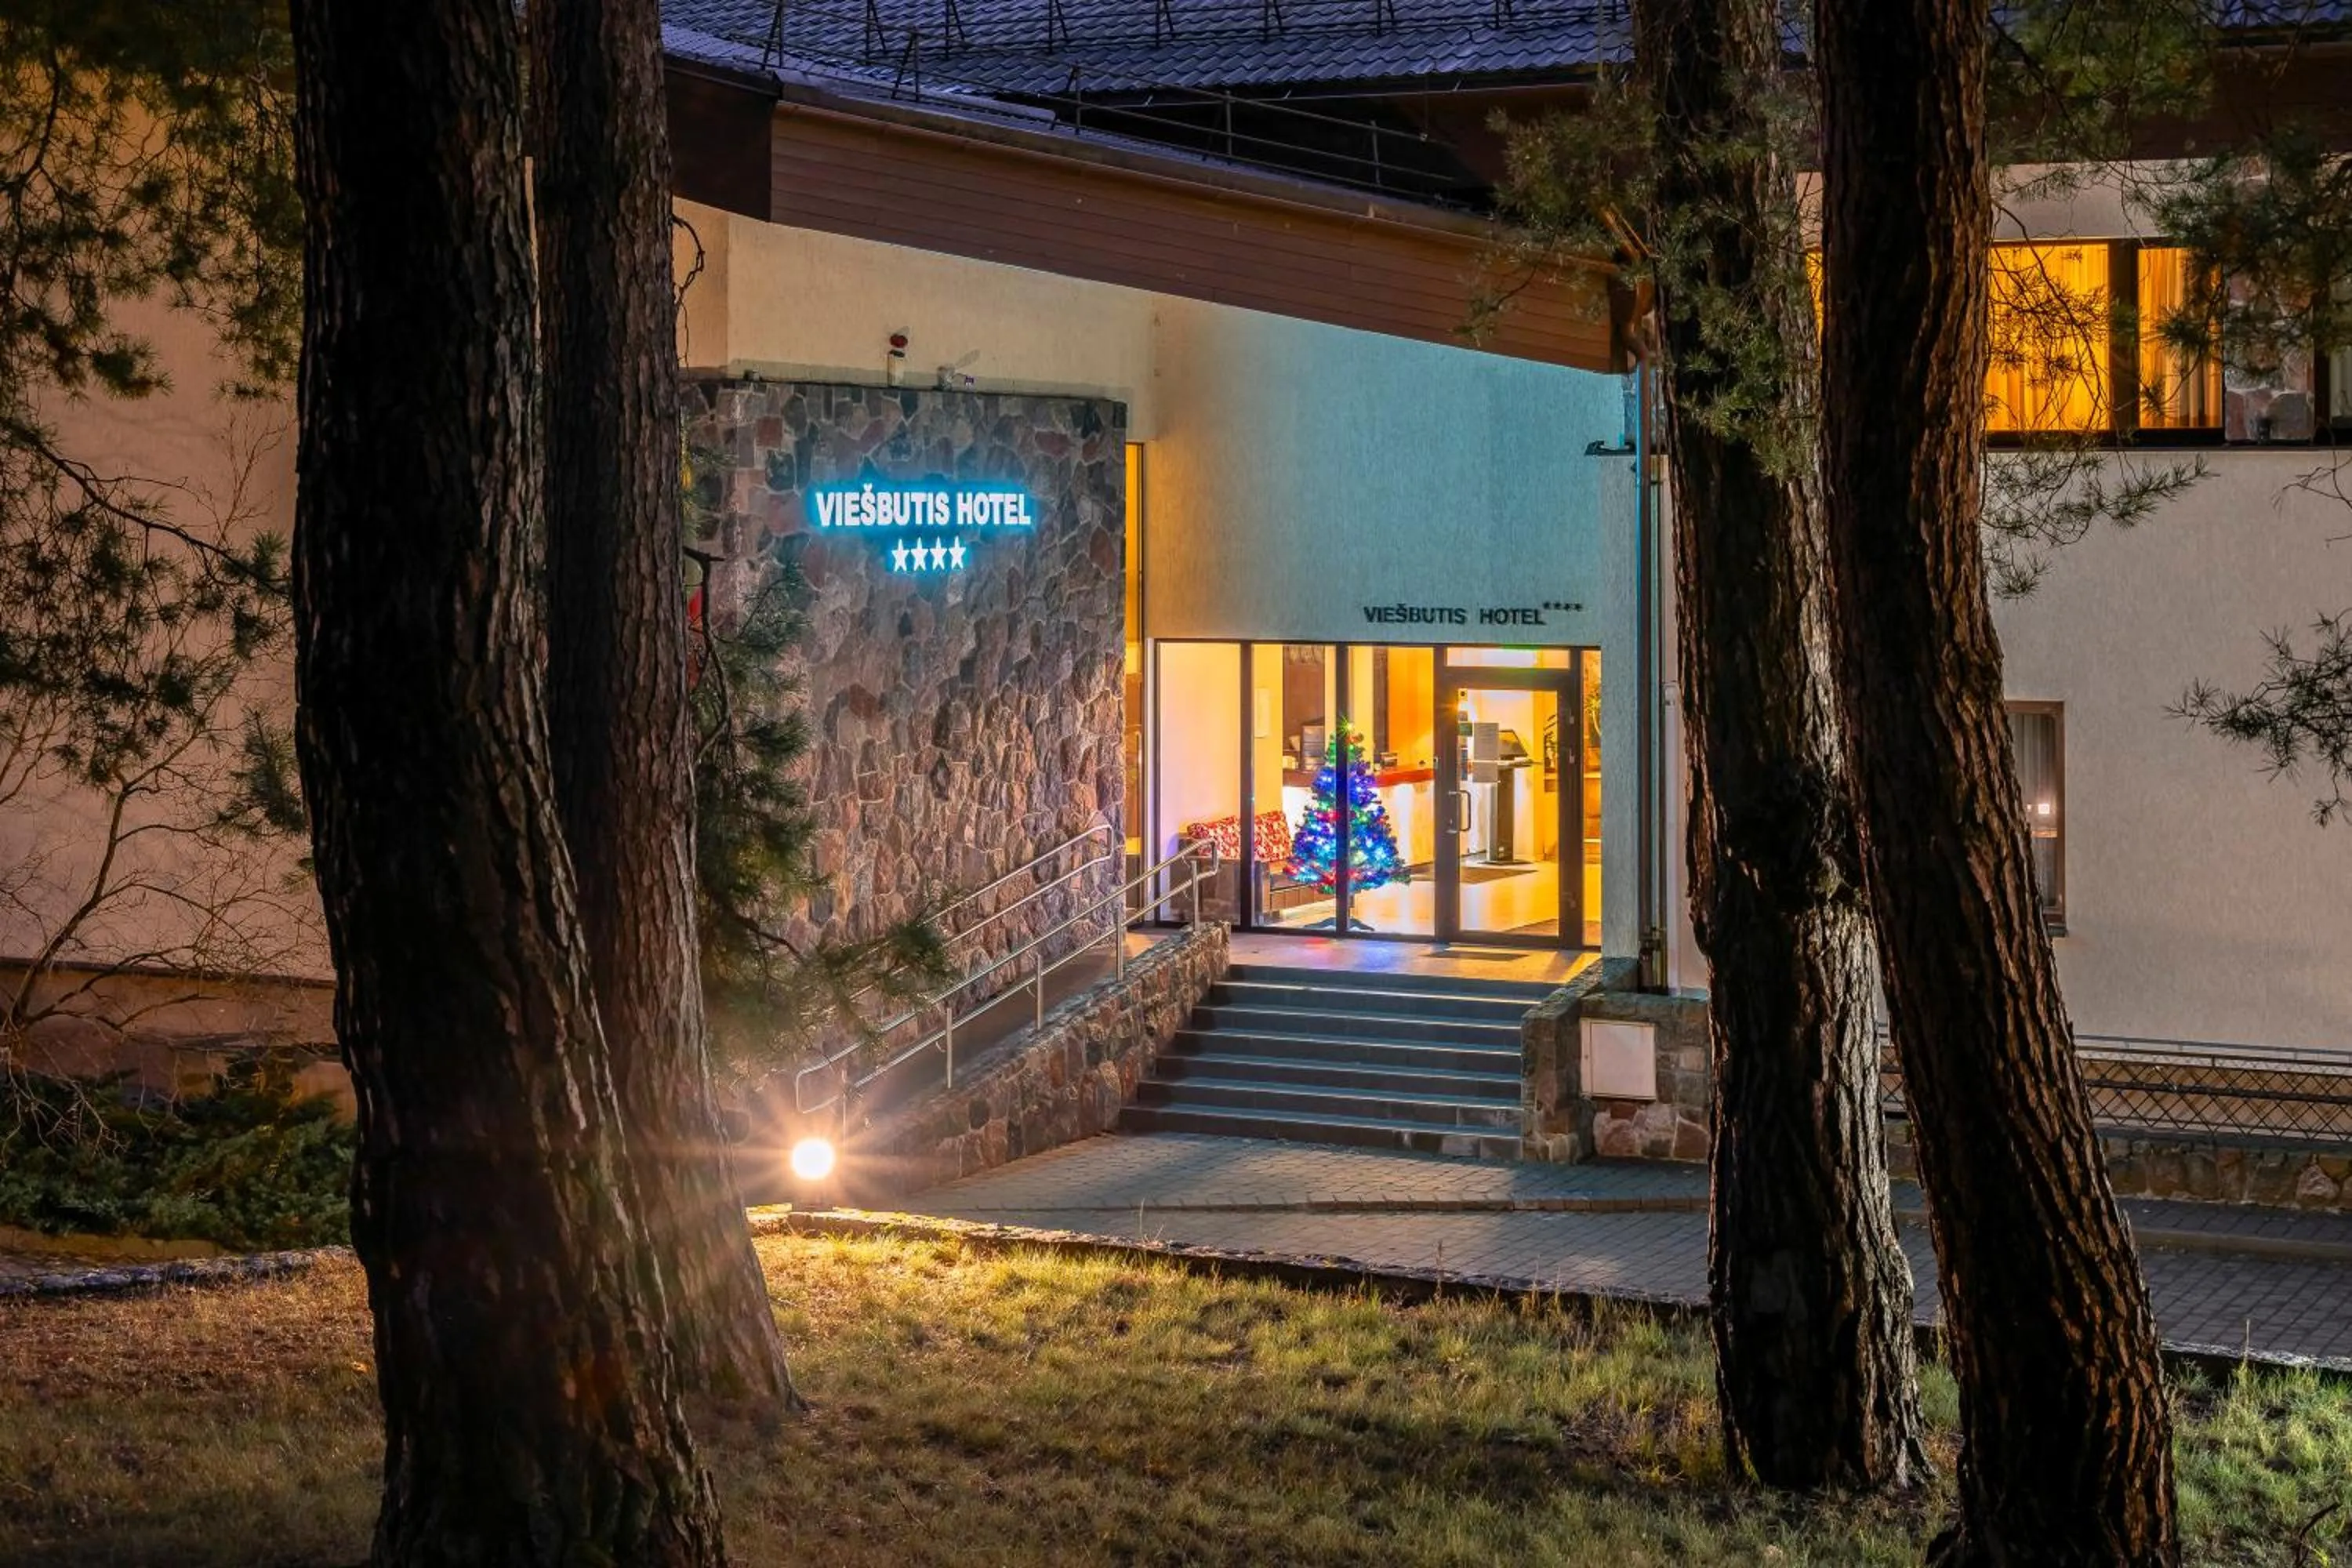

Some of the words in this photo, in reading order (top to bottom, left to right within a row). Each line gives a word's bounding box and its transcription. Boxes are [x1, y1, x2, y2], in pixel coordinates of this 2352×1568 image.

[815, 482, 950, 526] VIEŠBUTIS
[956, 492, 1031, 524] HOTEL
[1363, 603, 1467, 625] VIEŠBUTIS
[1479, 608, 1547, 626] HOTEL
